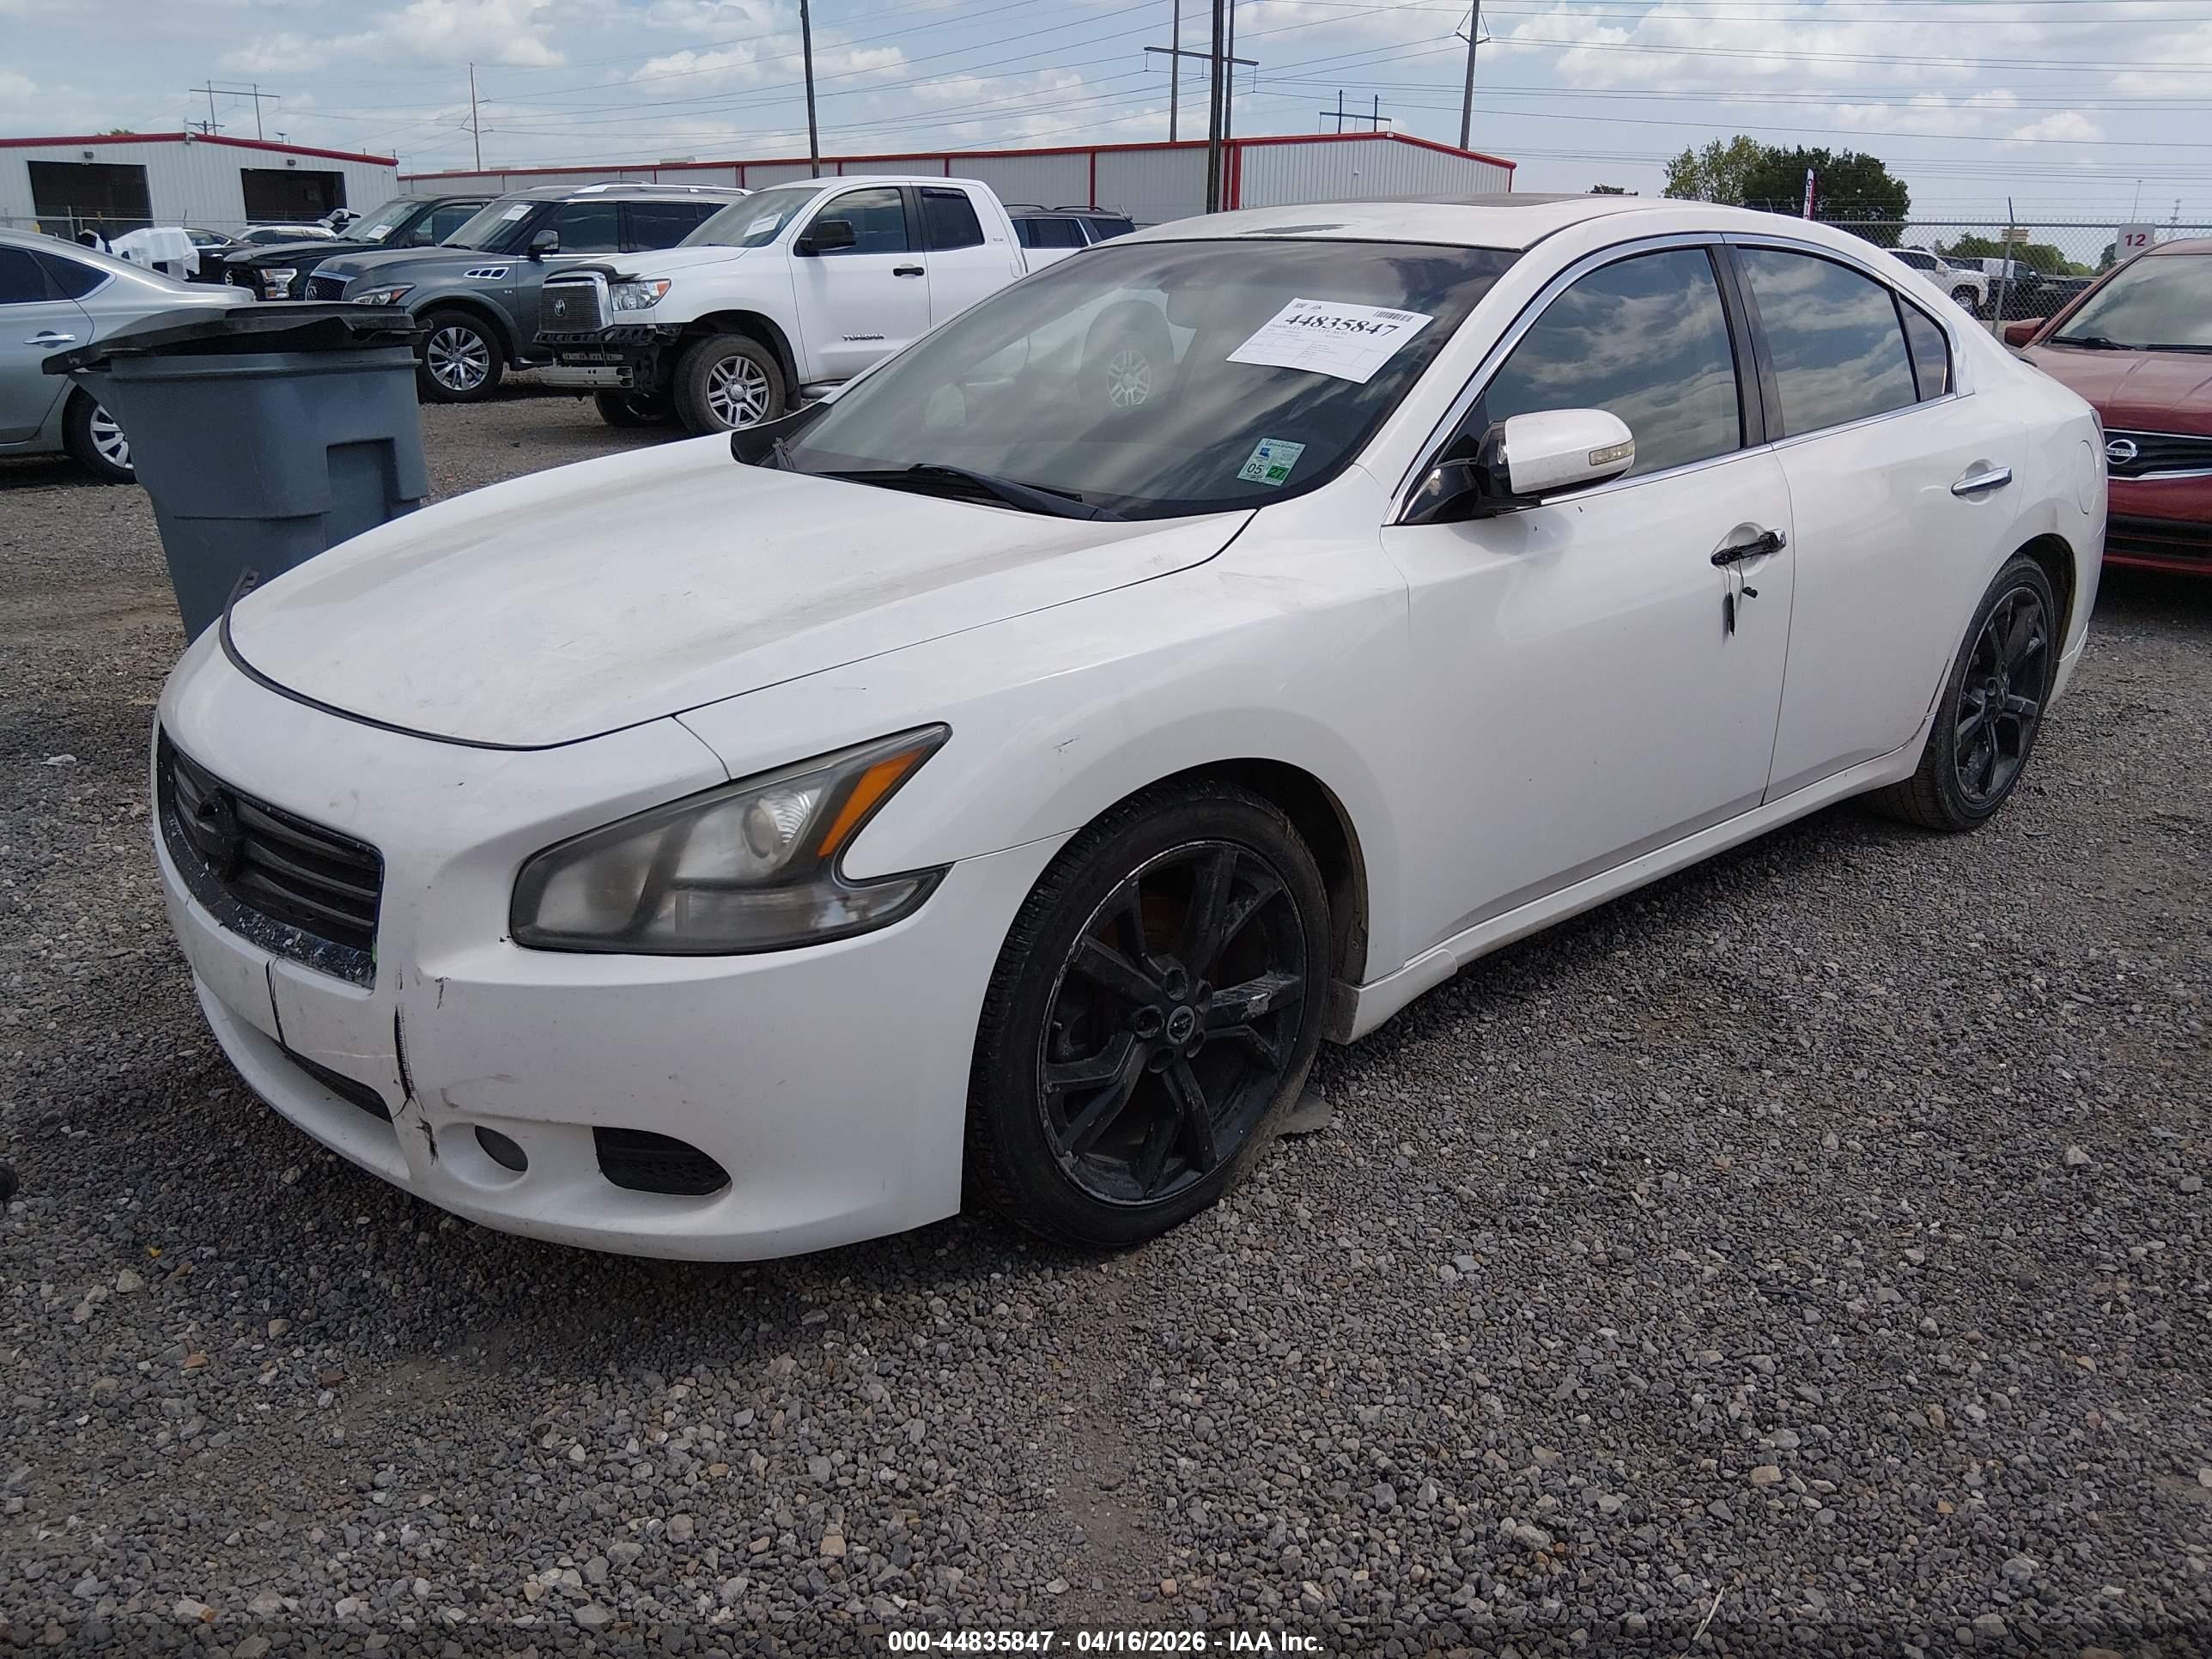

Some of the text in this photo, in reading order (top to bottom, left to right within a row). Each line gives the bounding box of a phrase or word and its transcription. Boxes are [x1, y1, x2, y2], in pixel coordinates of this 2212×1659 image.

[2125, 234, 2146, 246] 12
[1285, 313, 1401, 337] 44835847
[1247, 464, 1264, 475] 05
[1269, 467, 1286, 478] 27
